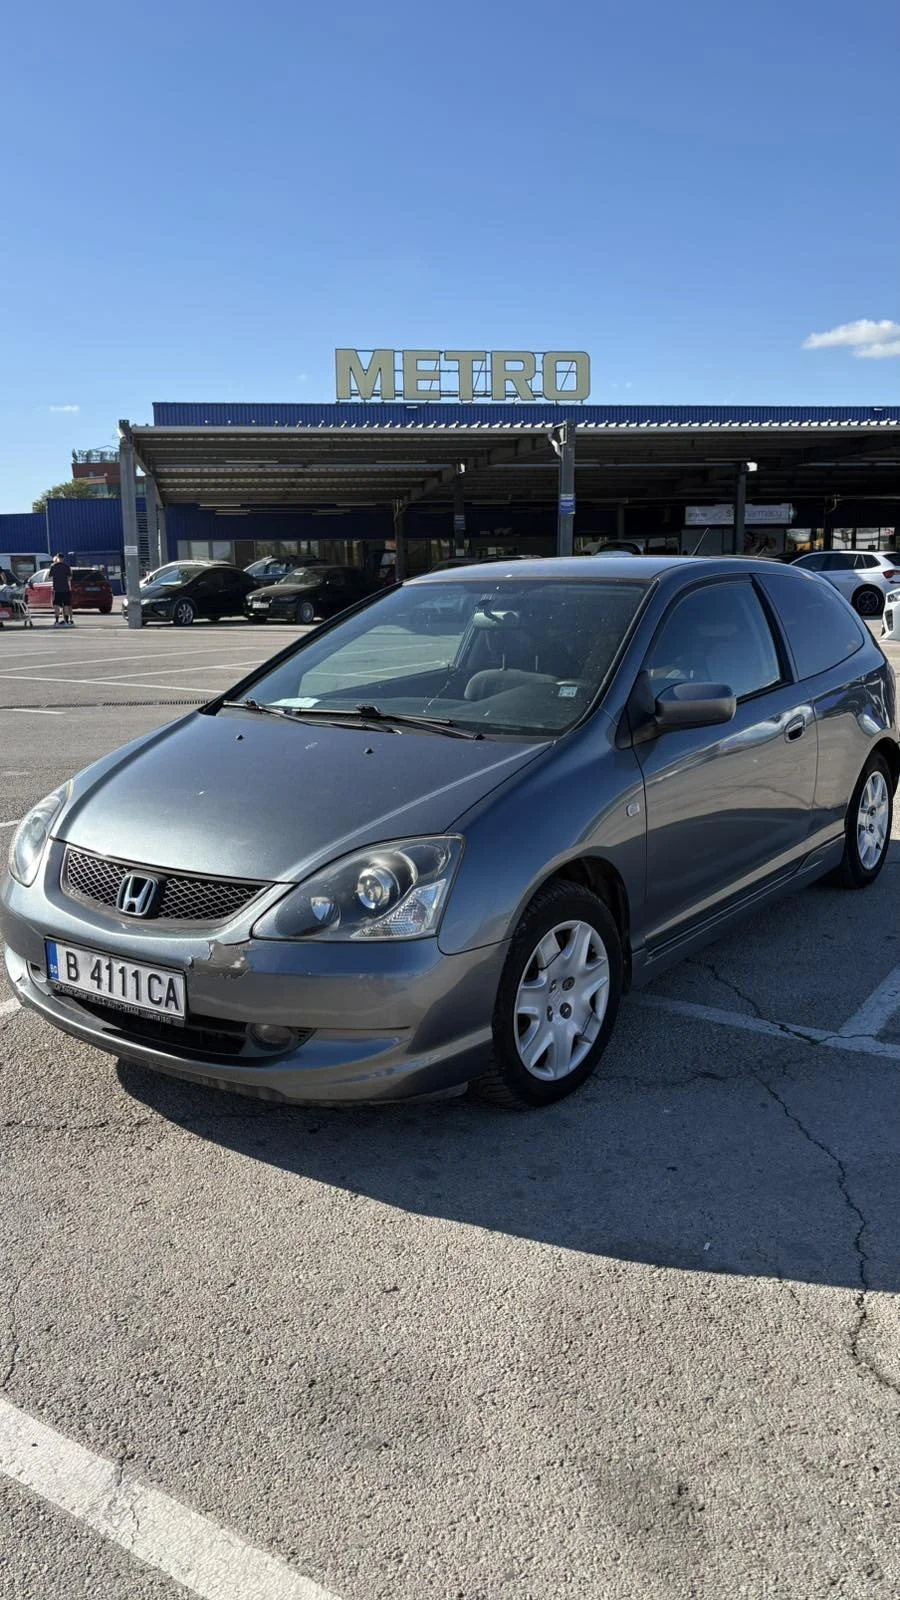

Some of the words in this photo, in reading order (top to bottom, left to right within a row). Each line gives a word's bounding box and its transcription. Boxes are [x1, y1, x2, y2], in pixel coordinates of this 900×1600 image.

[335, 348, 590, 401] METRO
[66, 951, 79, 981] B
[90, 958, 179, 1010] 4111CA
